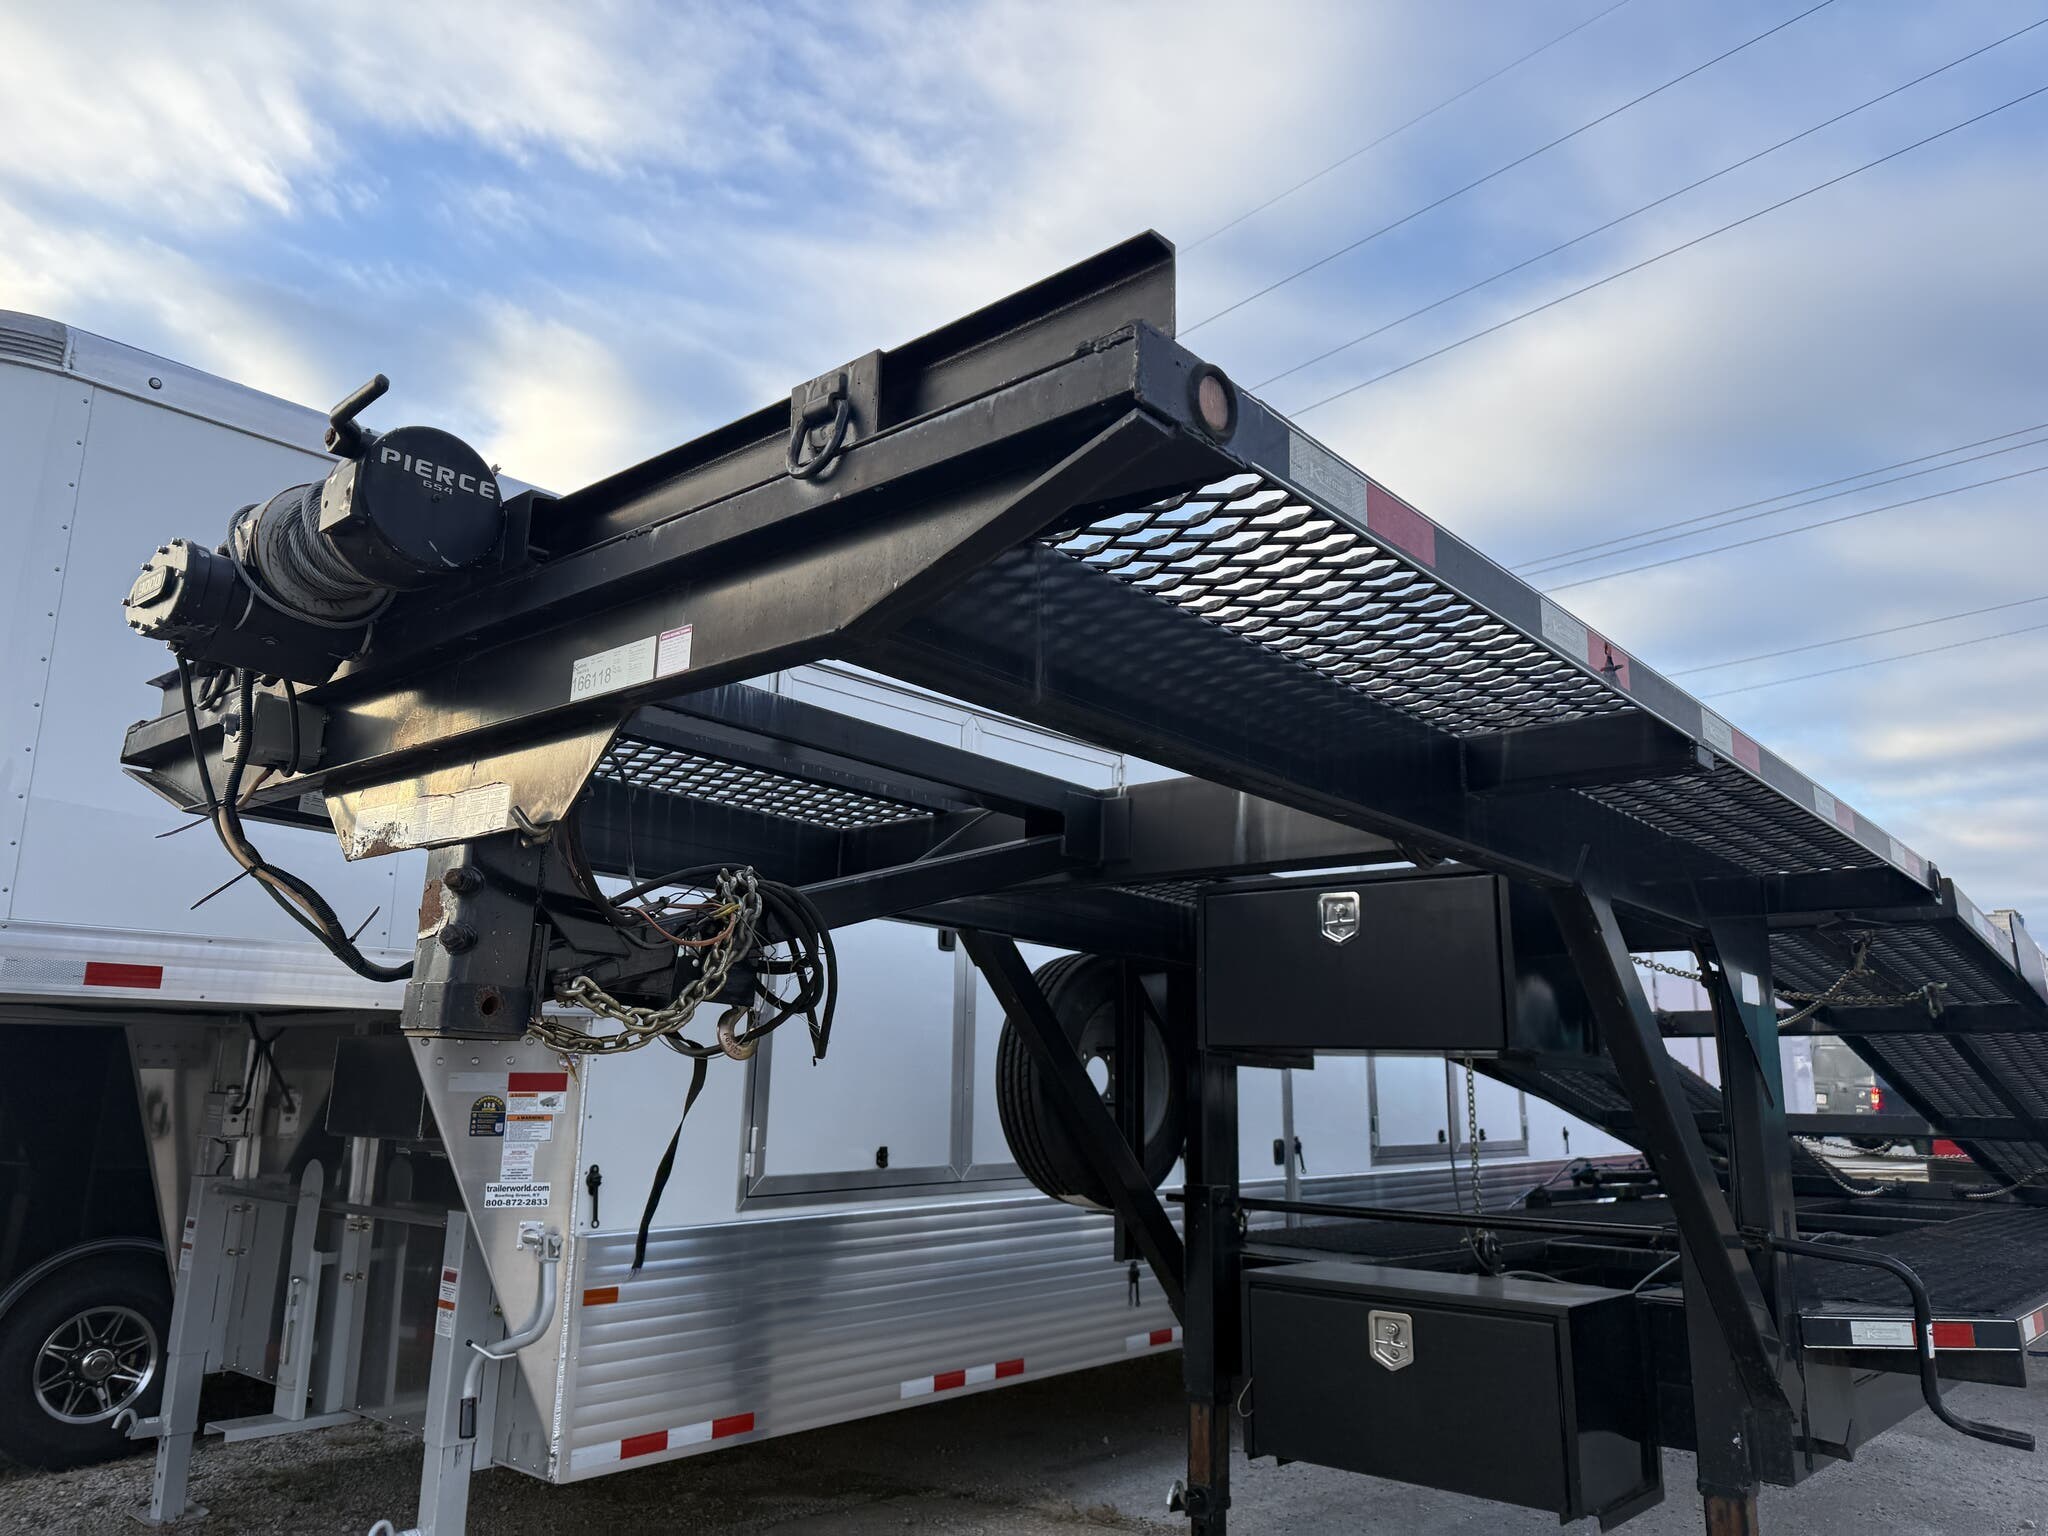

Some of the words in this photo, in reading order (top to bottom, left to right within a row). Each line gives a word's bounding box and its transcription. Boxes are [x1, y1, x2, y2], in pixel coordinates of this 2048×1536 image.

[380, 446, 496, 499] PIERCE
[573, 667, 611, 693] 166118
[486, 1184, 550, 1192] trailerworld.com
